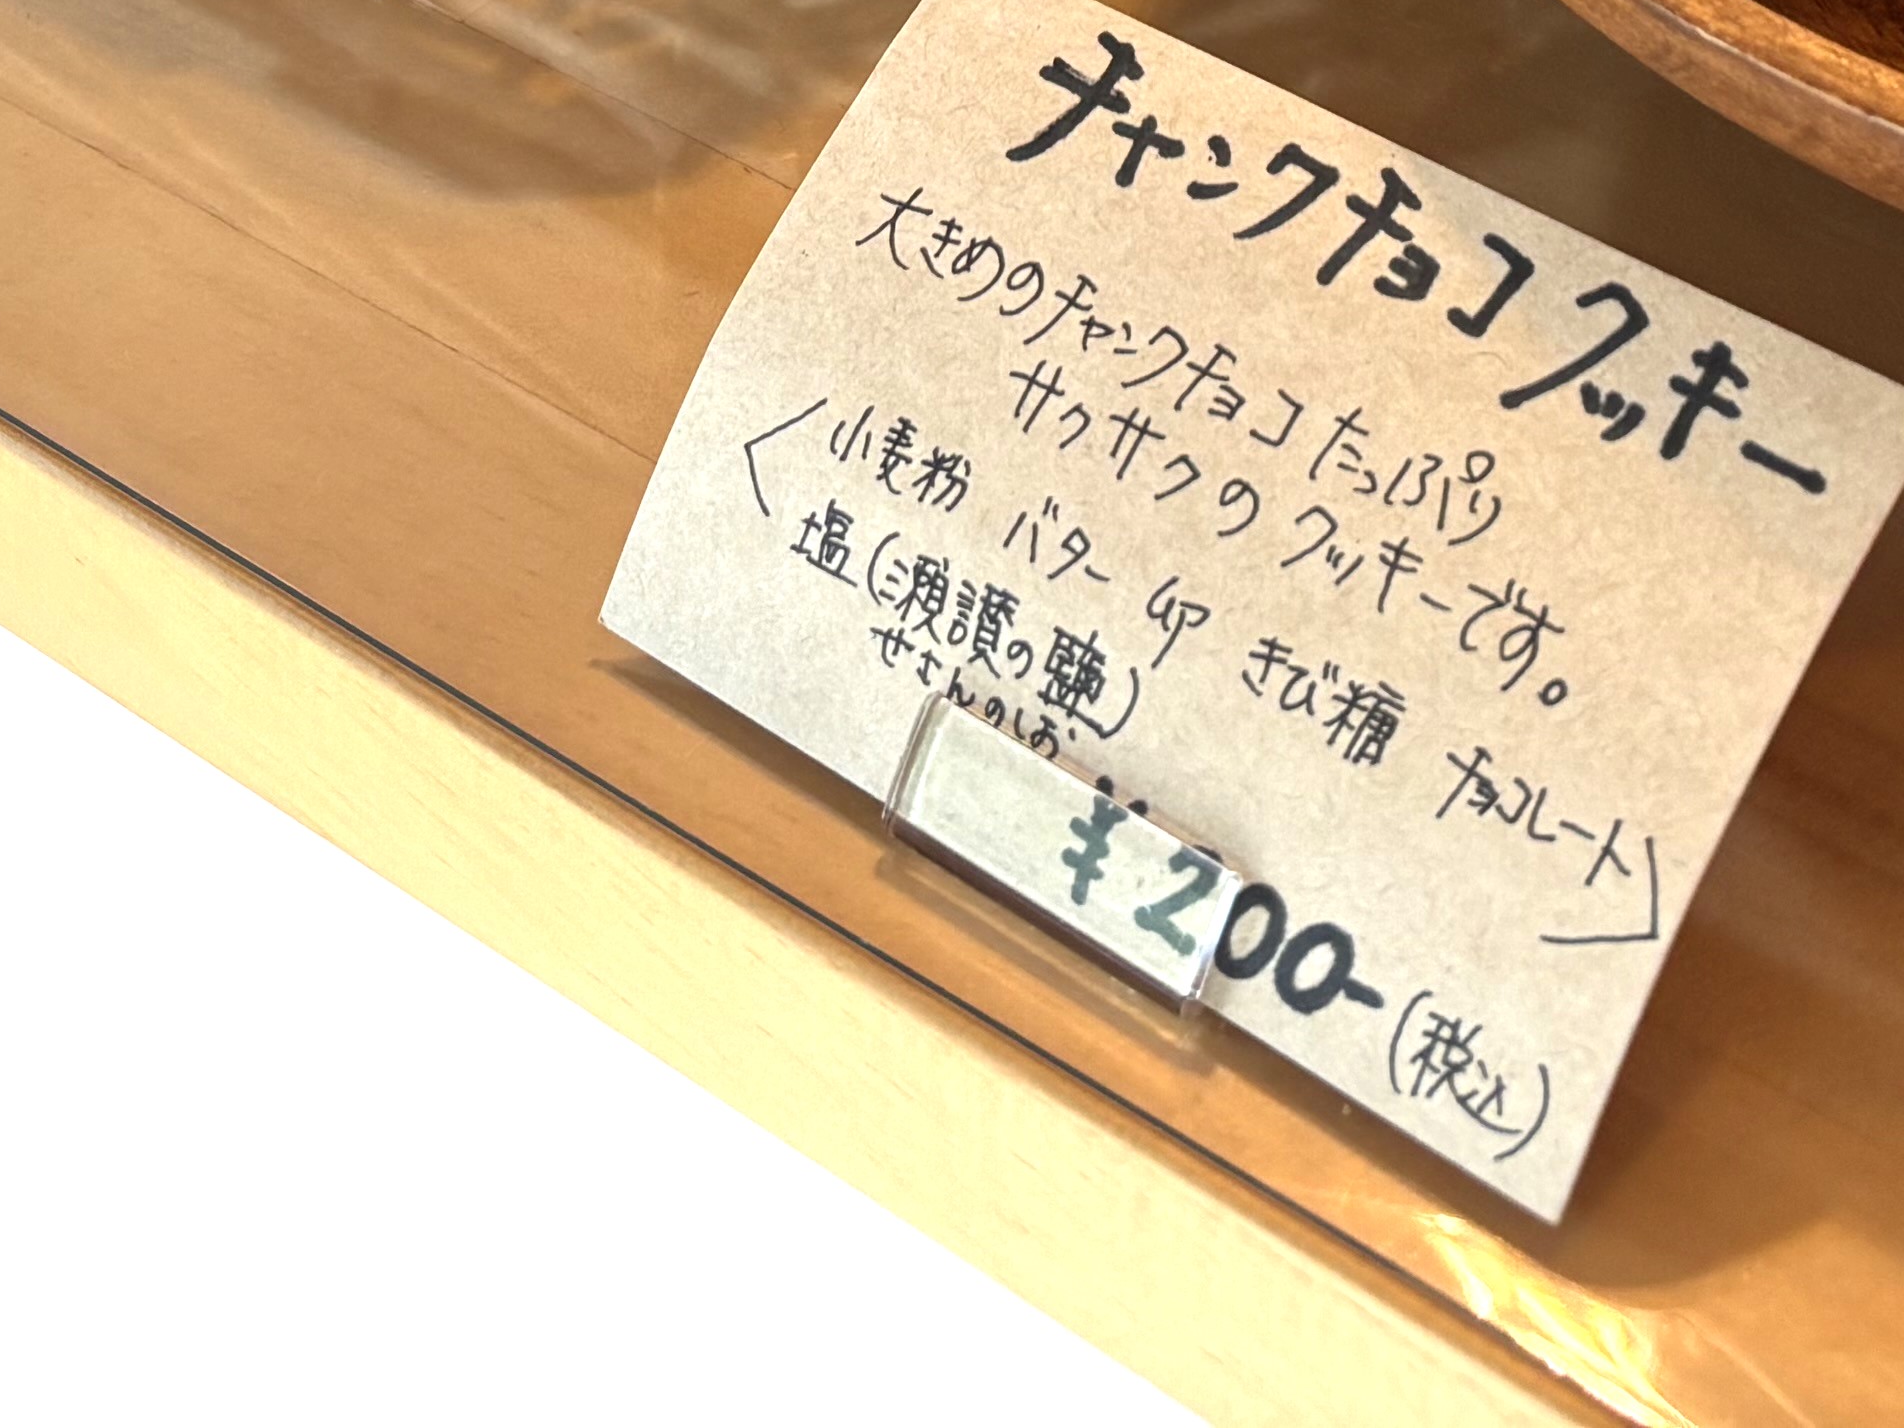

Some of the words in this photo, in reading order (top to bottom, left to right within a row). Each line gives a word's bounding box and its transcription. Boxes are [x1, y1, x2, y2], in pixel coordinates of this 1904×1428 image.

[829, 404, 973, 513] 小麦粉
[1002, 495, 1112, 584] バター
[1240, 635, 1409, 770] きび糖
[1386, 990, 1552, 1165] (税込)
